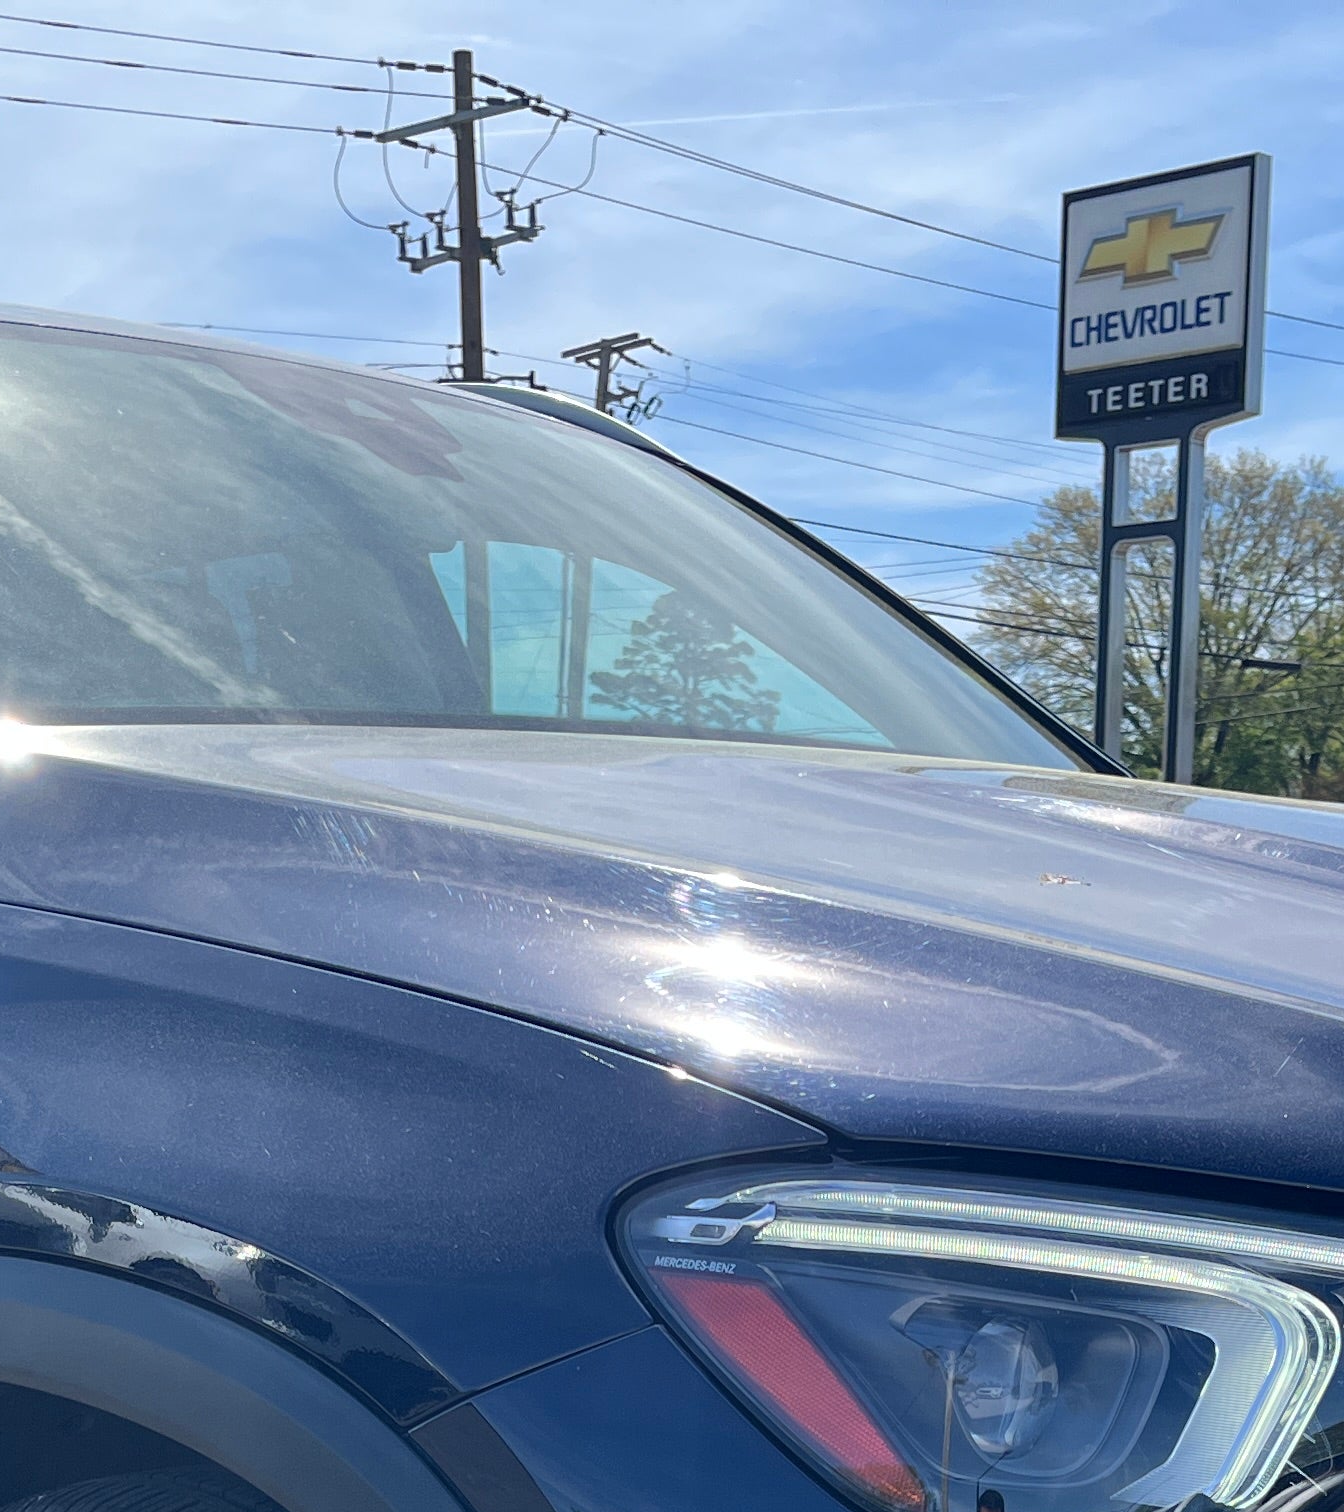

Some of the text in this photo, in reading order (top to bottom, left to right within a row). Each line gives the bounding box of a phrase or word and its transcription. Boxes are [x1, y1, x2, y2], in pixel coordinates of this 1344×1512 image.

[1070, 291, 1233, 348] CHEVROLET
[1087, 373, 1209, 413] TEETER
[654, 1255, 737, 1275] MERCEDES-BENZ
